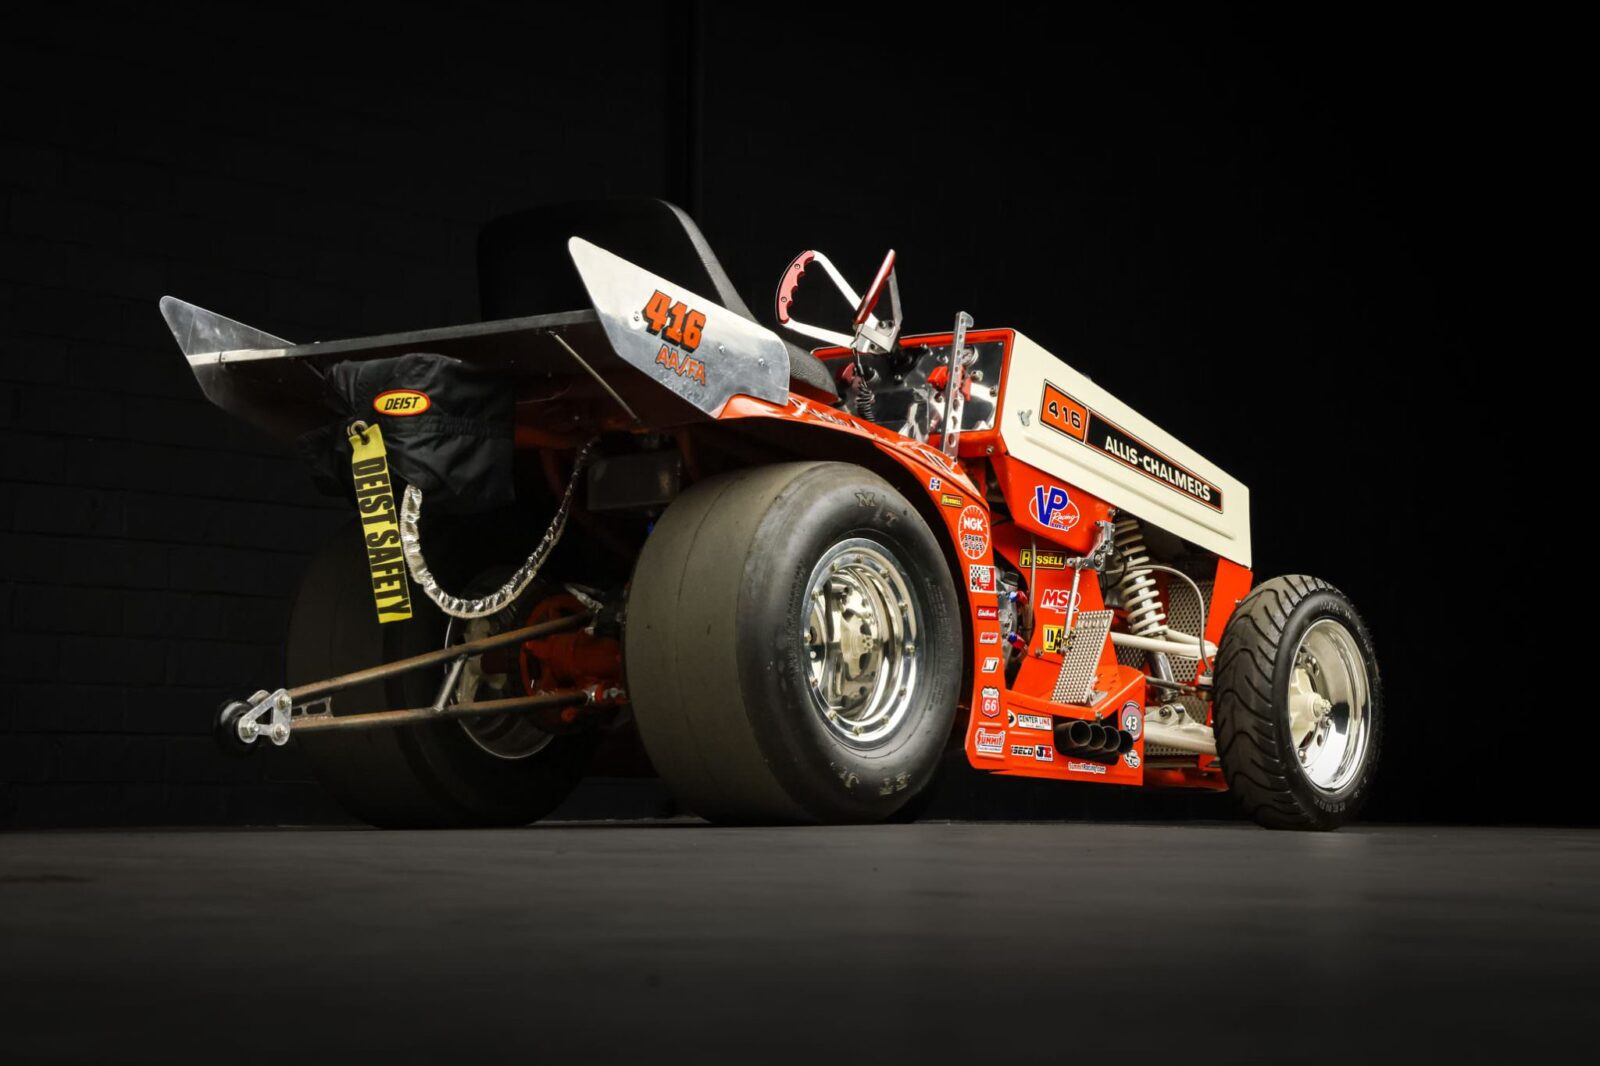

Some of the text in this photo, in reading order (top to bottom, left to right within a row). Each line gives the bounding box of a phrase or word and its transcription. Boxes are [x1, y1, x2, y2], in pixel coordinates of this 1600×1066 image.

[642, 290, 706, 353] 416
[655, 344, 705, 386] AA/FA
[384, 396, 421, 411] DEIST
[1048, 401, 1082, 430] 416
[1104, 436, 1212, 502] ALLIS-CHALMERS
[1035, 485, 1069, 527] VP
[963, 517, 984, 532] NGK
[352, 456, 412, 616] DEIST SAFETY
[1021, 551, 1064, 566] RSSELL
[984, 699, 997, 711] 66
[1019, 714, 1039, 722] CENTER
[1125, 716, 1138, 731] 43
[1036, 746, 1052, 758] JE
